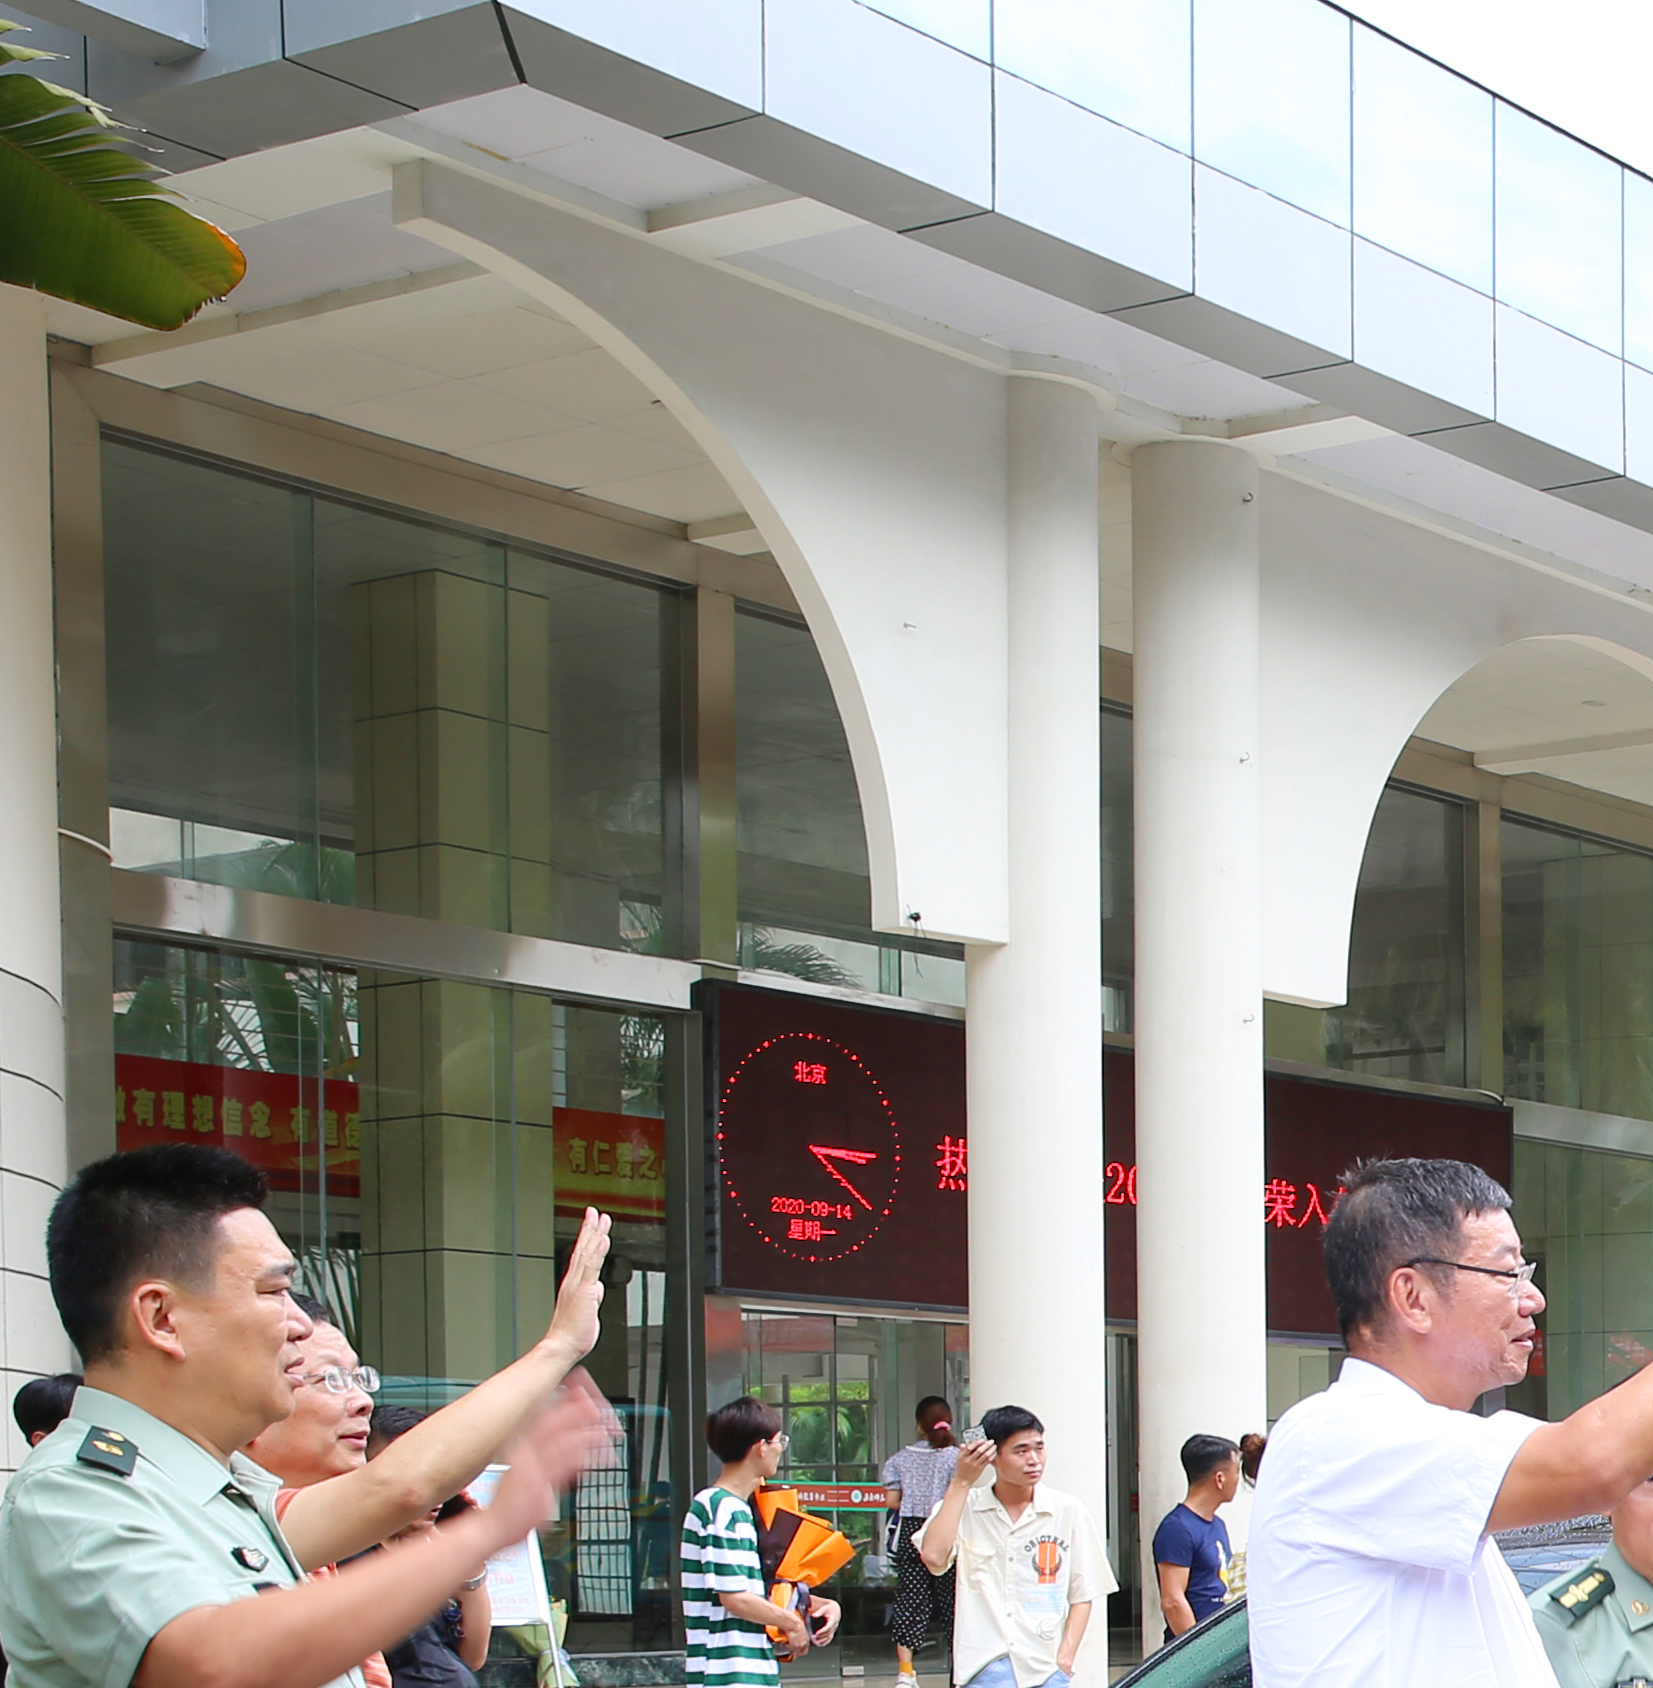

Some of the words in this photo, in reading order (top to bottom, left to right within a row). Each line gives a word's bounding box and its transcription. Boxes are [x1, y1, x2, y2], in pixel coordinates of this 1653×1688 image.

[794, 1061, 828, 1084] 北京
[569, 1137, 665, 1180] 有仁爱之
[771, 1196, 854, 1220] 2020-09-14
[788, 1218, 838, 1242] 星期一
